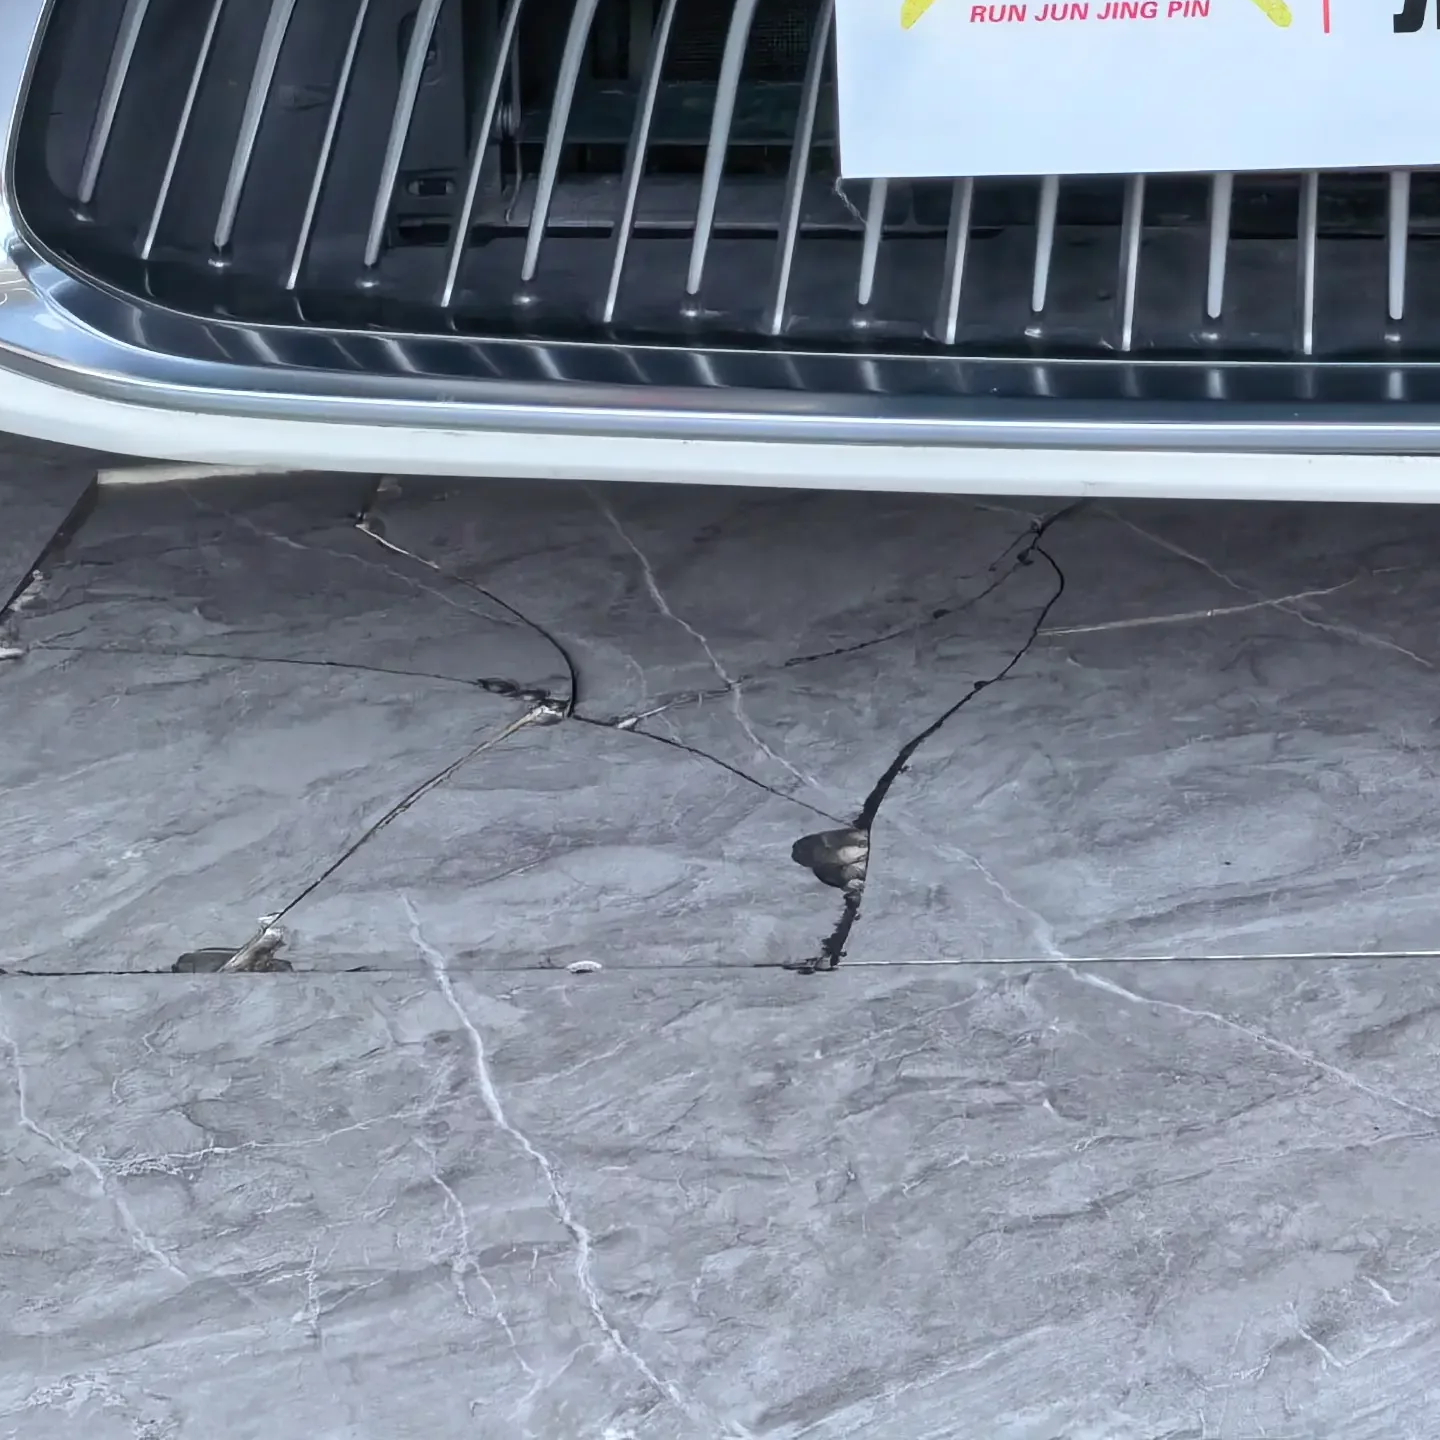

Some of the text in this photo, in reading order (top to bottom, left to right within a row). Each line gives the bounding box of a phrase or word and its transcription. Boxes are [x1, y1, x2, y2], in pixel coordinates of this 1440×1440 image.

[969, 0, 1210, 23] RUN JUN JING PIN
